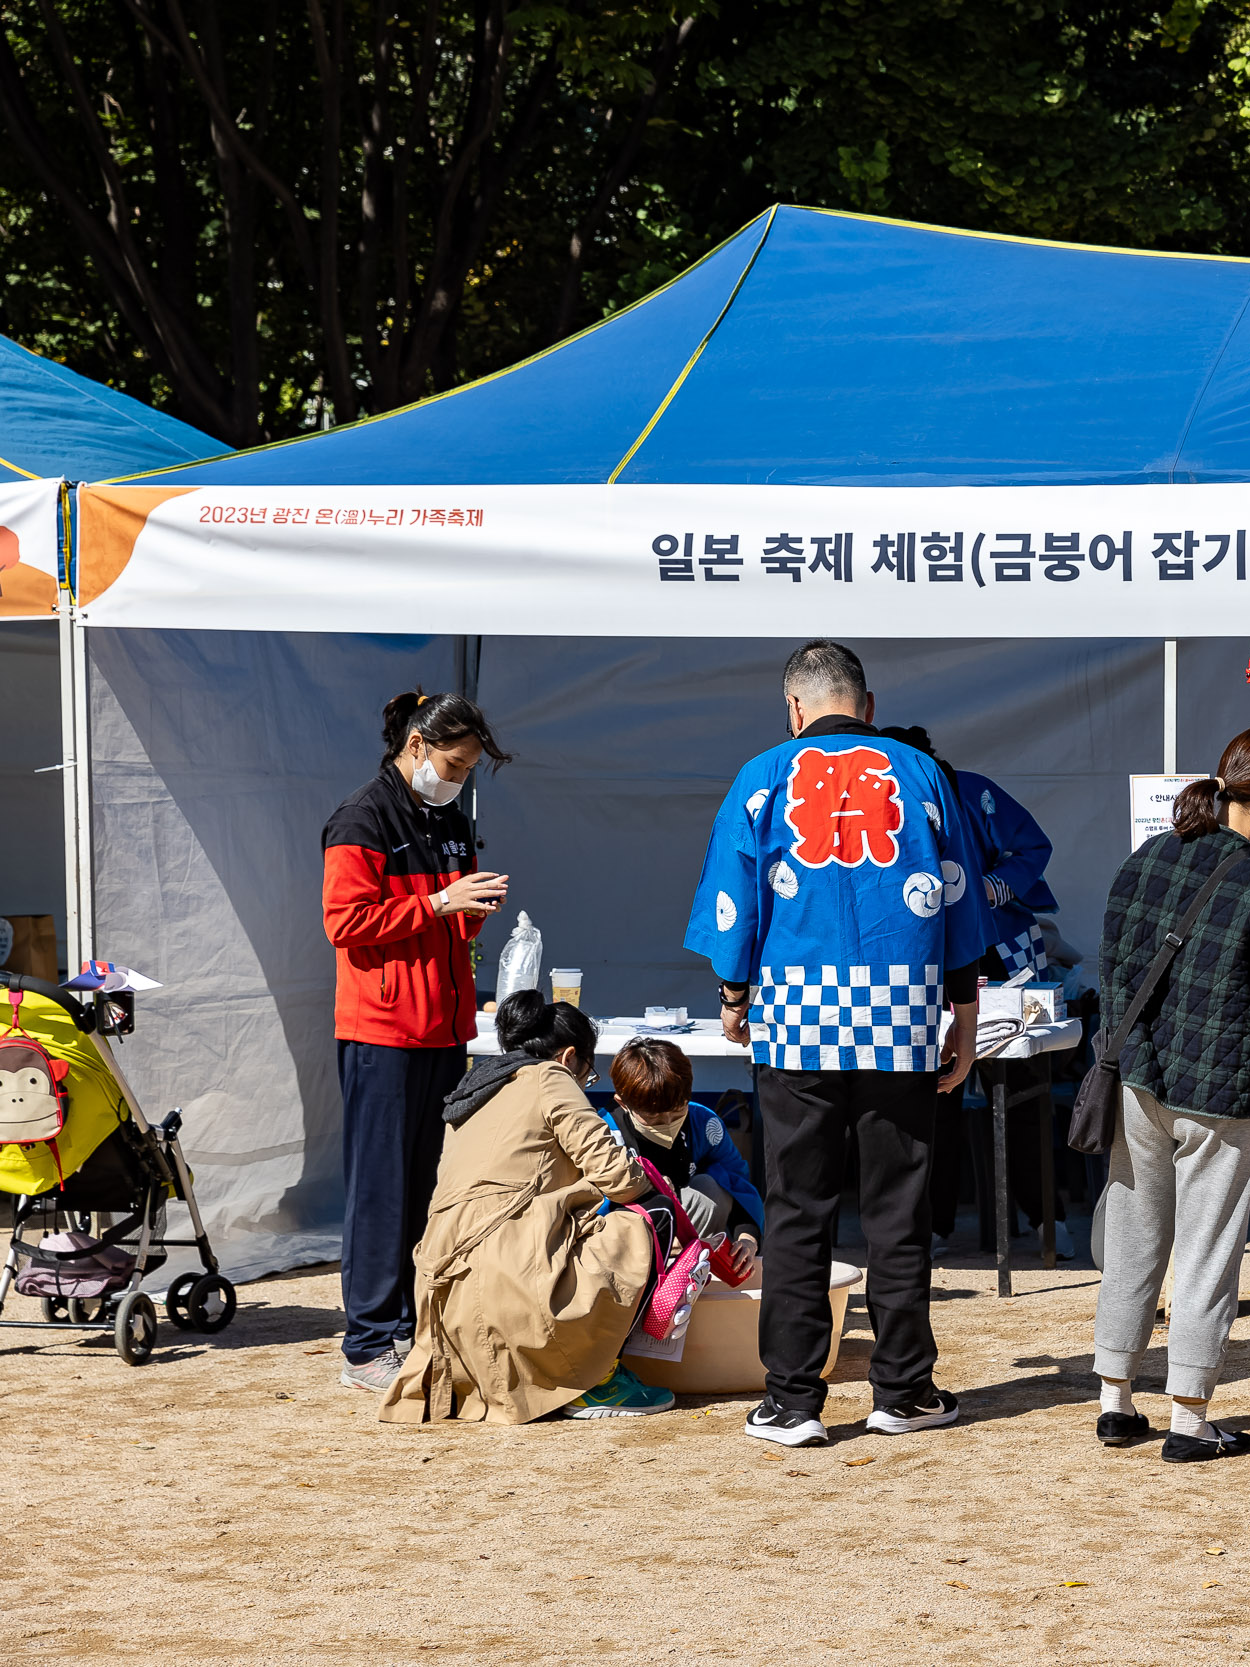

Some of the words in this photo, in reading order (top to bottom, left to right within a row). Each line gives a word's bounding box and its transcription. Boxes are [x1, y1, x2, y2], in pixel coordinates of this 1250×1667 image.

[198, 505, 267, 524] 2023년
[272, 507, 310, 524] 광진
[409, 508, 484, 527] 가족축제
[651, 532, 744, 582] 일본
[760, 532, 854, 583] 축제
[871, 530, 1133, 588] 체험(금붕어
[1151, 529, 1247, 581] 잡기
[1155, 794, 1178, 803] 안내사
